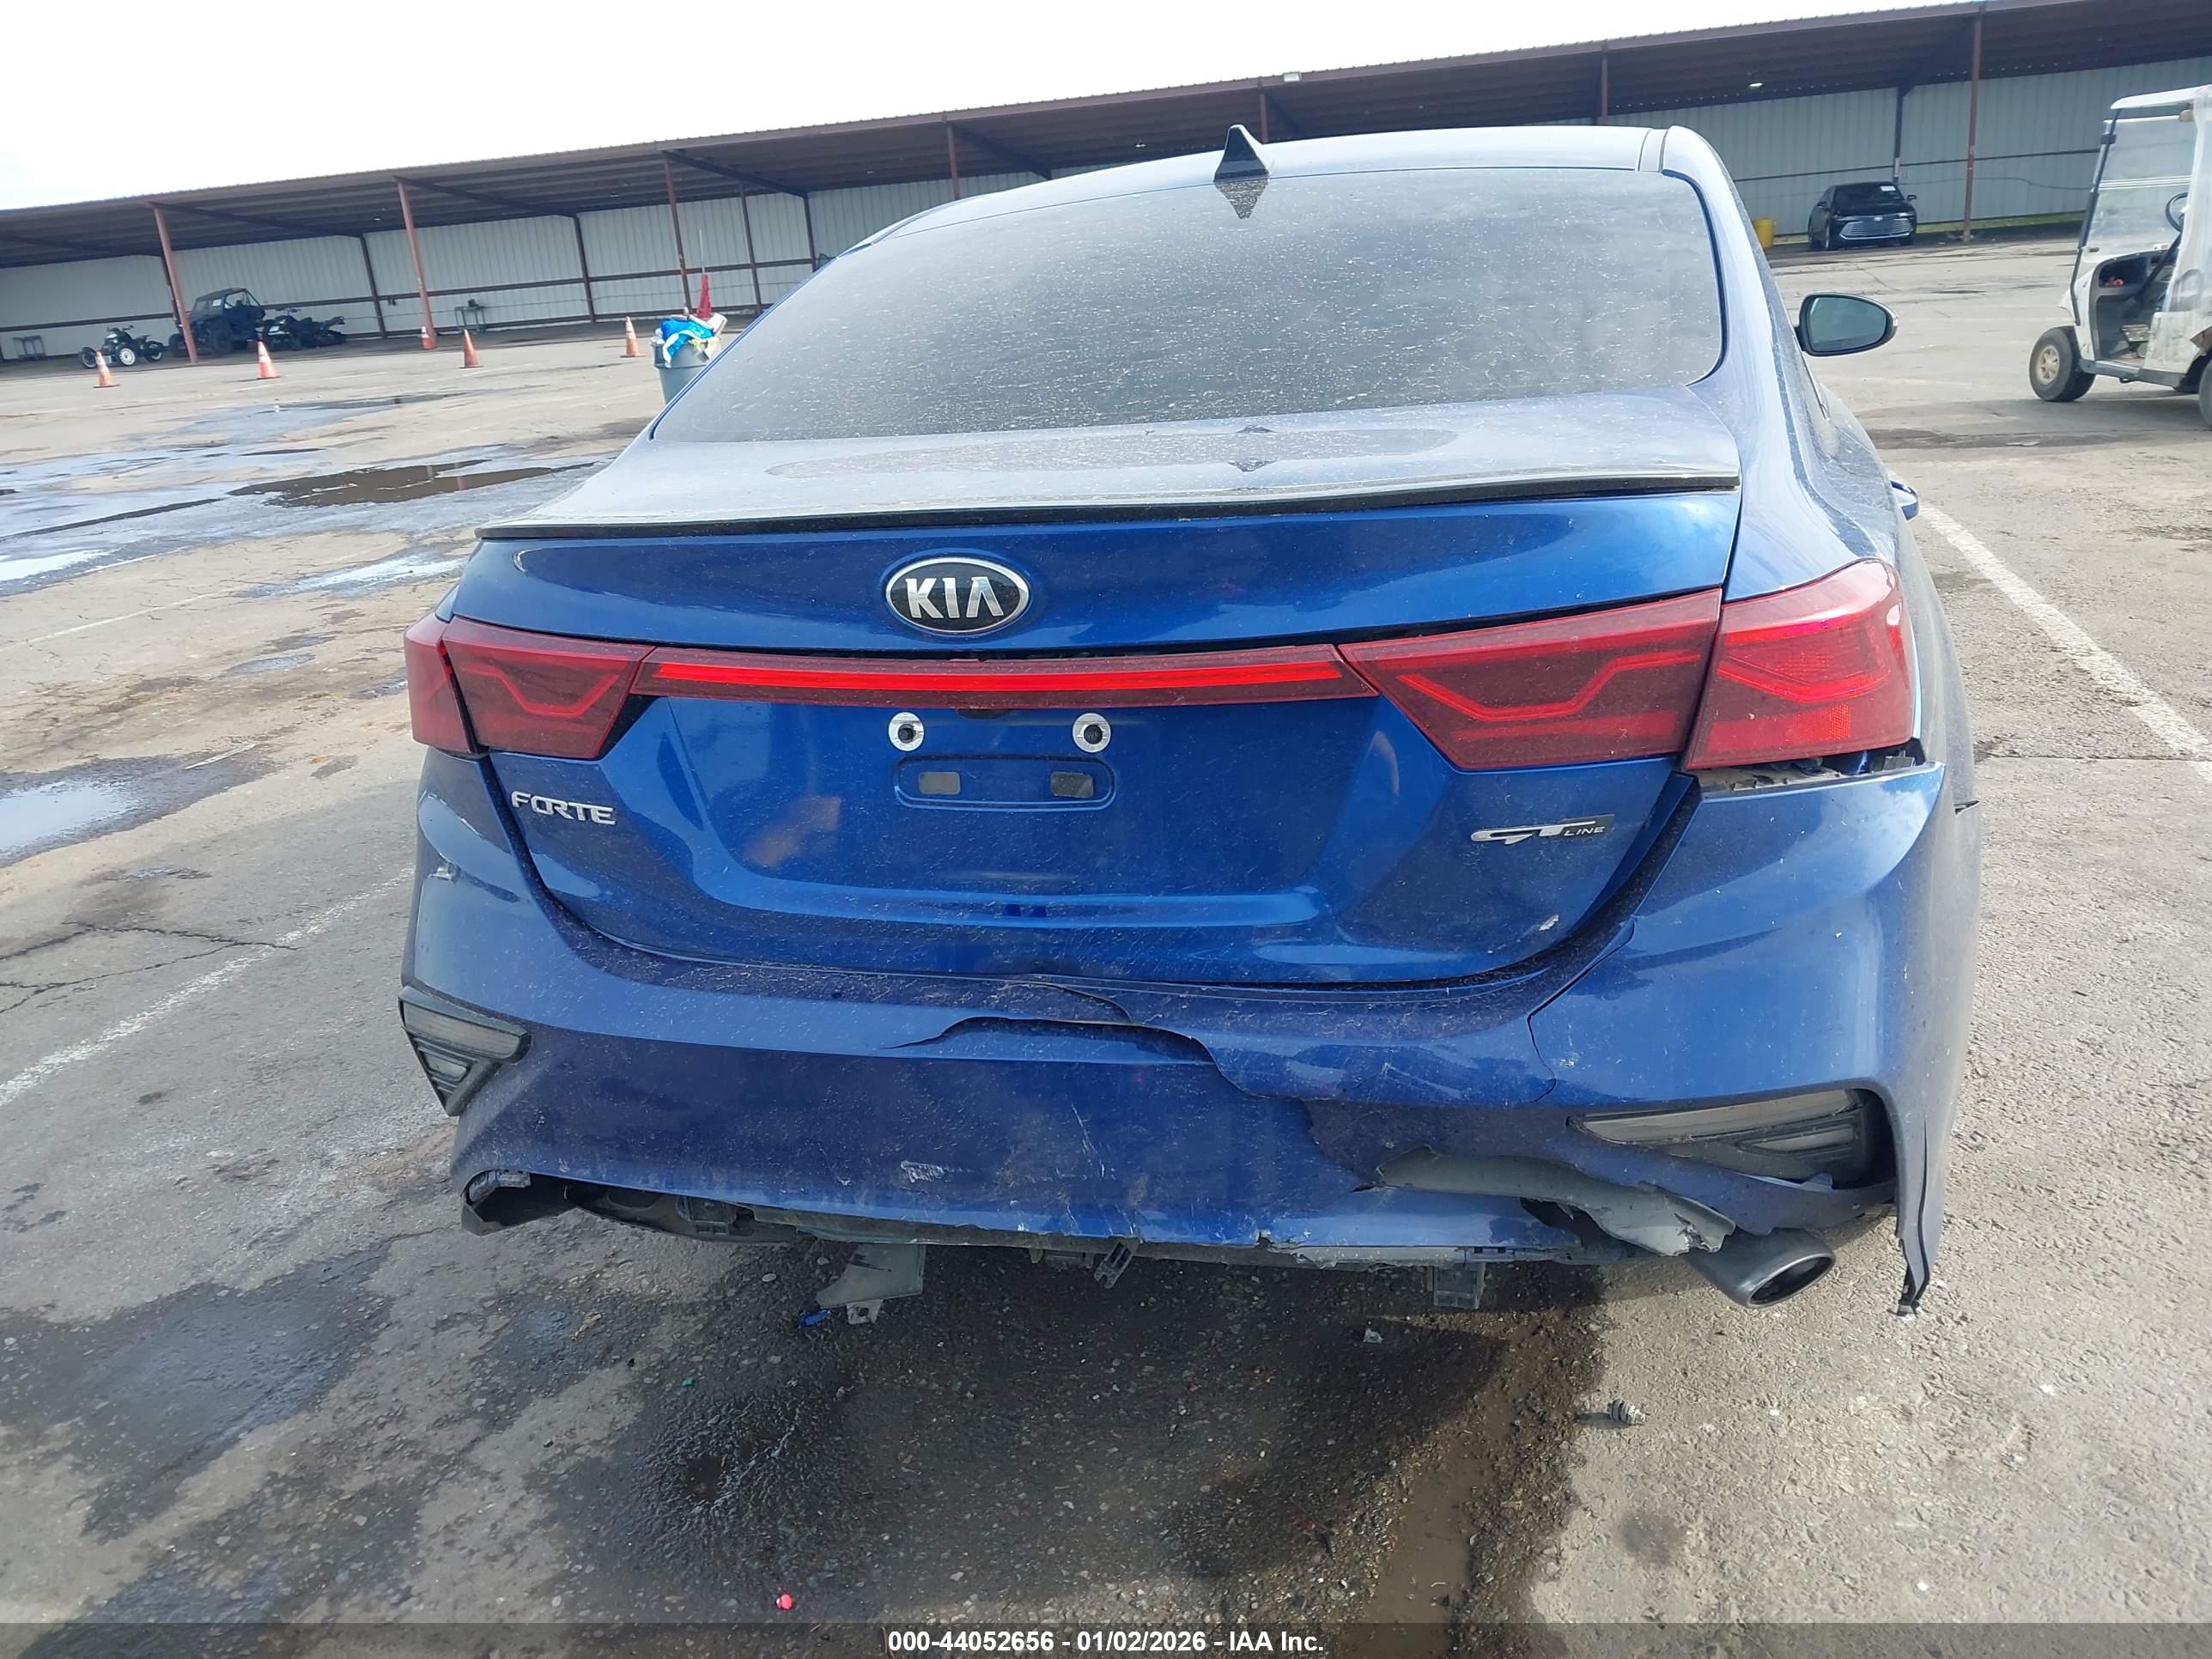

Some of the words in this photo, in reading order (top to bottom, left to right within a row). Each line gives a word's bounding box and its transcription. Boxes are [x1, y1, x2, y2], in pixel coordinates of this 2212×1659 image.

[905, 576, 1004, 619] KIA
[511, 791, 616, 825] FORTE
[1470, 820, 1596, 845] GT
[1564, 826, 1605, 836] LINE
